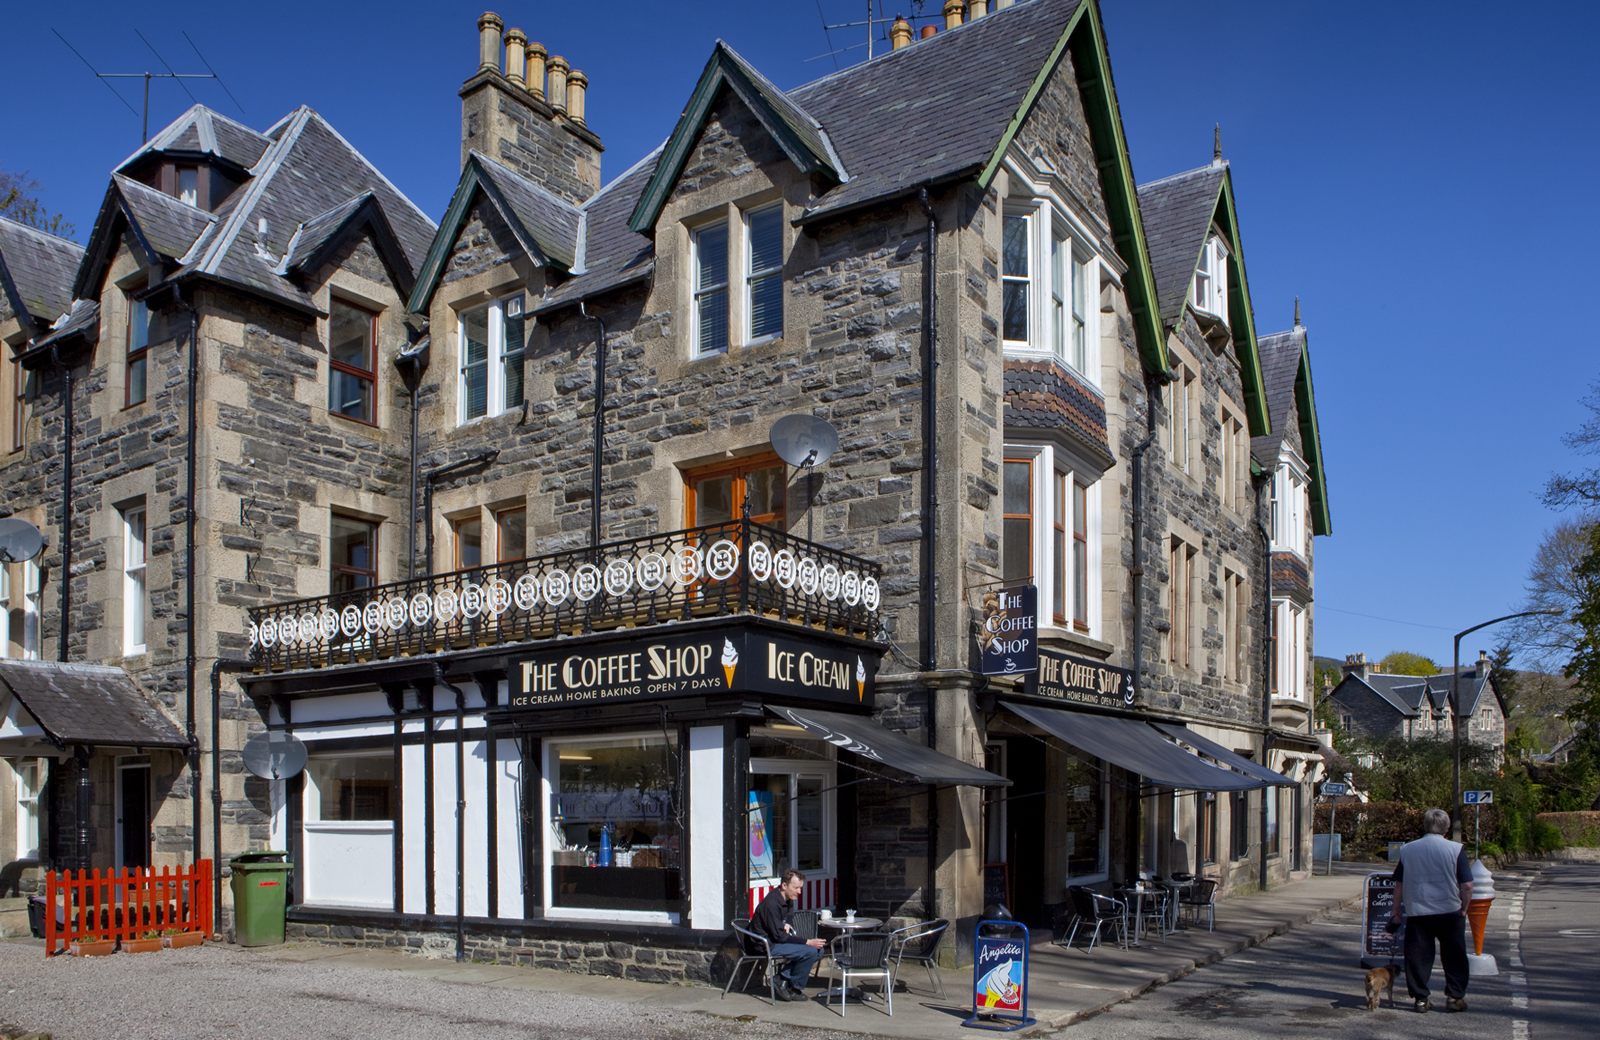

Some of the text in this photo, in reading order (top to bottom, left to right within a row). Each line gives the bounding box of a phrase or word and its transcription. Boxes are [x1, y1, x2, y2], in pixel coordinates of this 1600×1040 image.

[998, 592, 1023, 610] THE
[985, 615, 1034, 634] COFFEE
[991, 637, 1029, 656] SHOP
[519, 644, 713, 693] THE COFFEE SHOP
[768, 642, 850, 691] ICE CREAM
[1038, 654, 1122, 694] THE COFFEE SHOP
[512, 677, 721, 706] ICE CREAM HOME BAKING OPEN 7 DAYS
[1037, 685, 1046, 695] ICE
[1047, 687, 1064, 698] CREAM
[1067, 690, 1081, 701] HOME
[1082, 693, 1099, 704] BAKING
[1101, 696, 1112, 706] OPEN
[1116, 699, 1126, 708] DAYS
[1468, 793, 1476, 801] P
[979, 943, 1021, 964] Angelito
